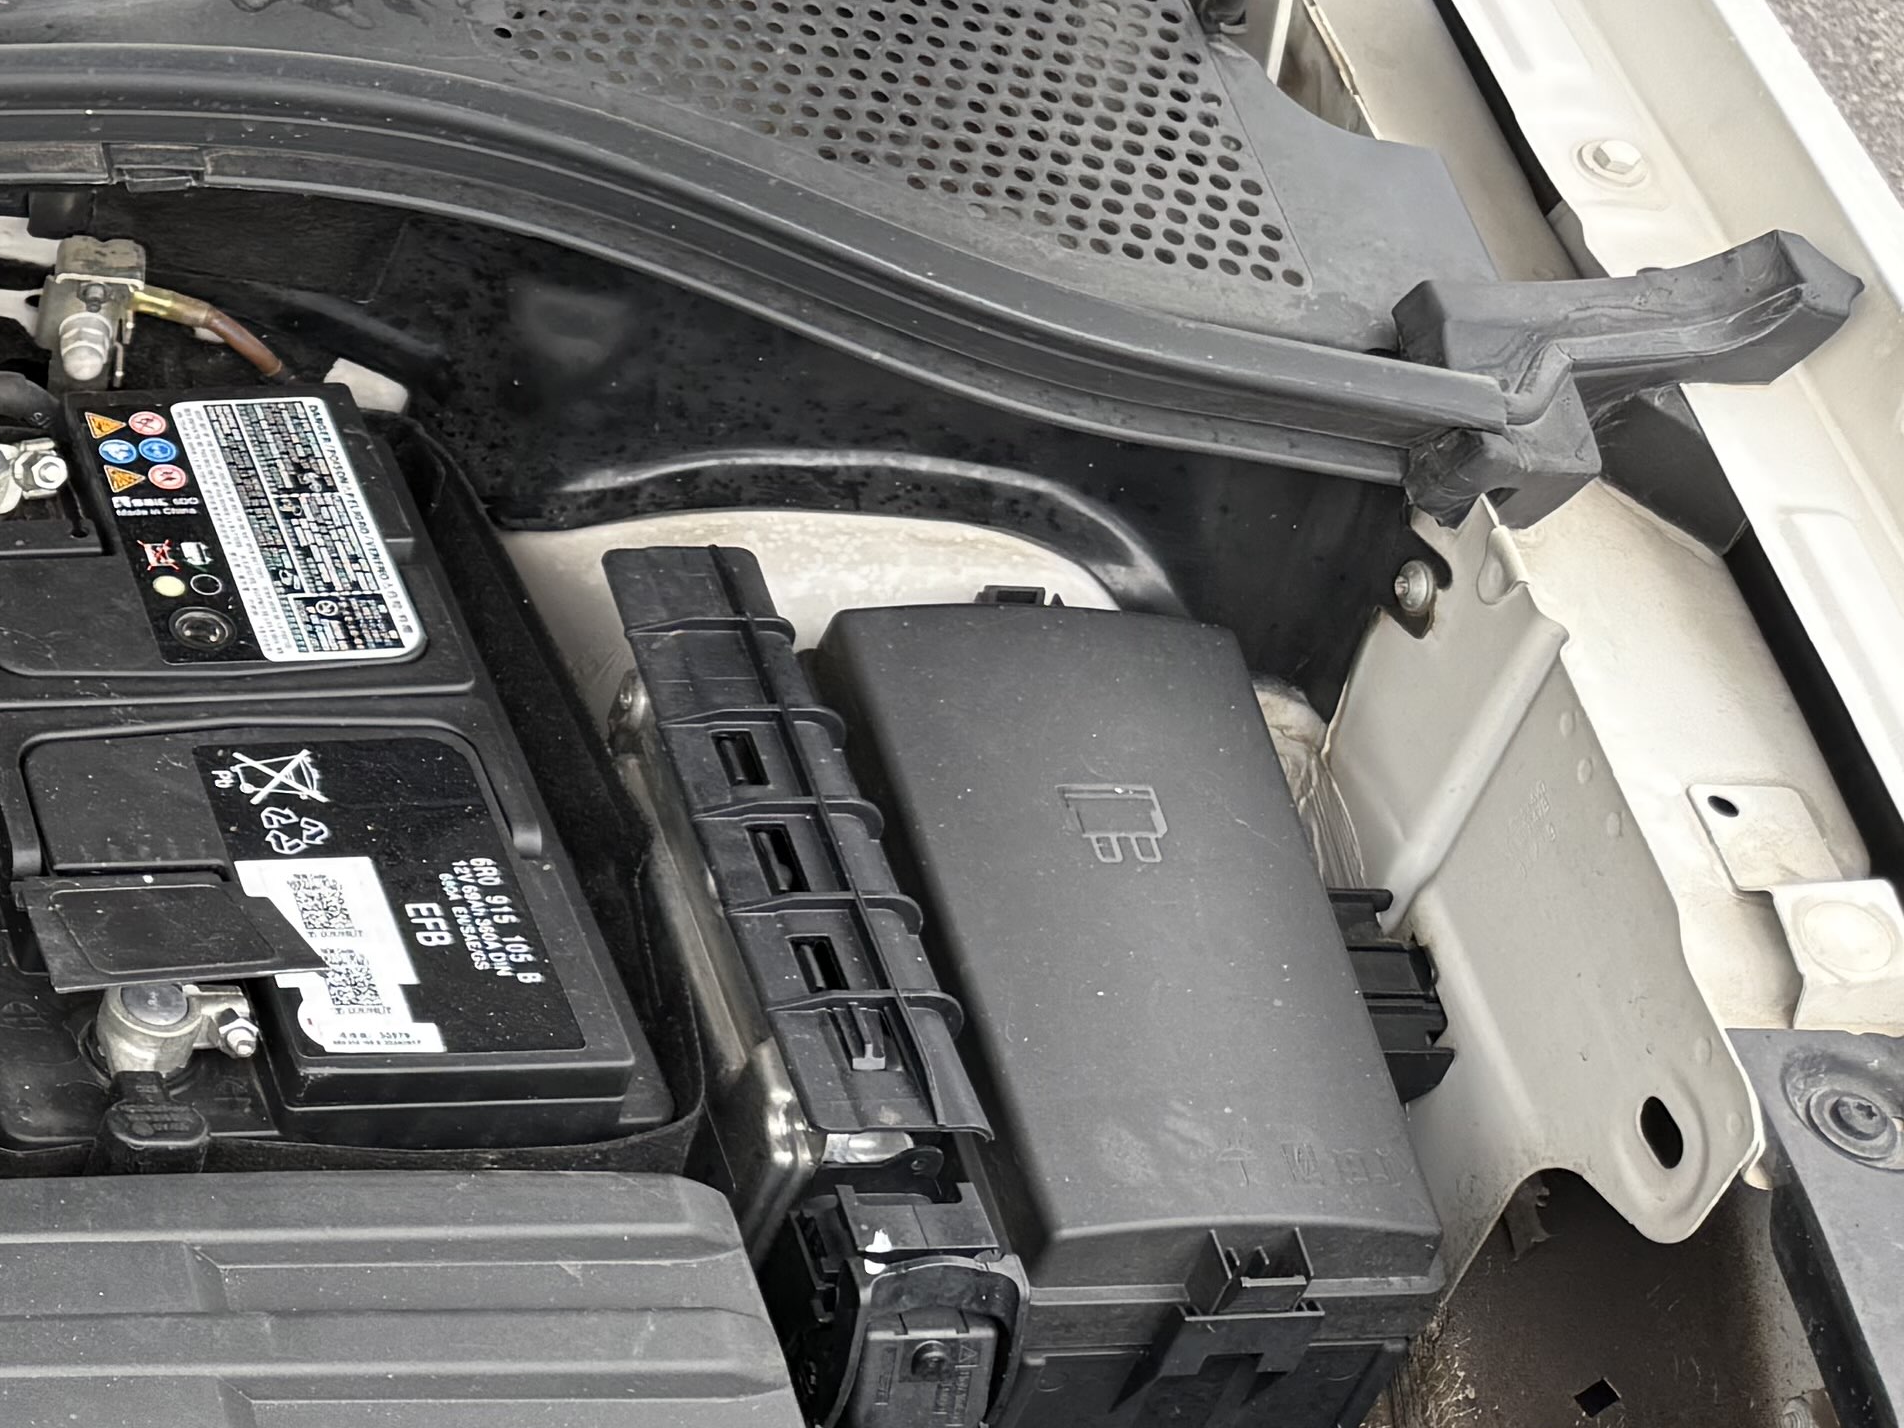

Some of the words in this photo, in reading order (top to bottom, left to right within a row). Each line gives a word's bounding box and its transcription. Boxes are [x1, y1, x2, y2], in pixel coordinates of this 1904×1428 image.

[451, 859, 476, 883] 12V
[488, 952, 516, 977] DIN
[485, 895, 521, 924] 915
[405, 903, 456, 948] EFB
[502, 934, 537, 963] 105
[516, 972, 546, 984] B
